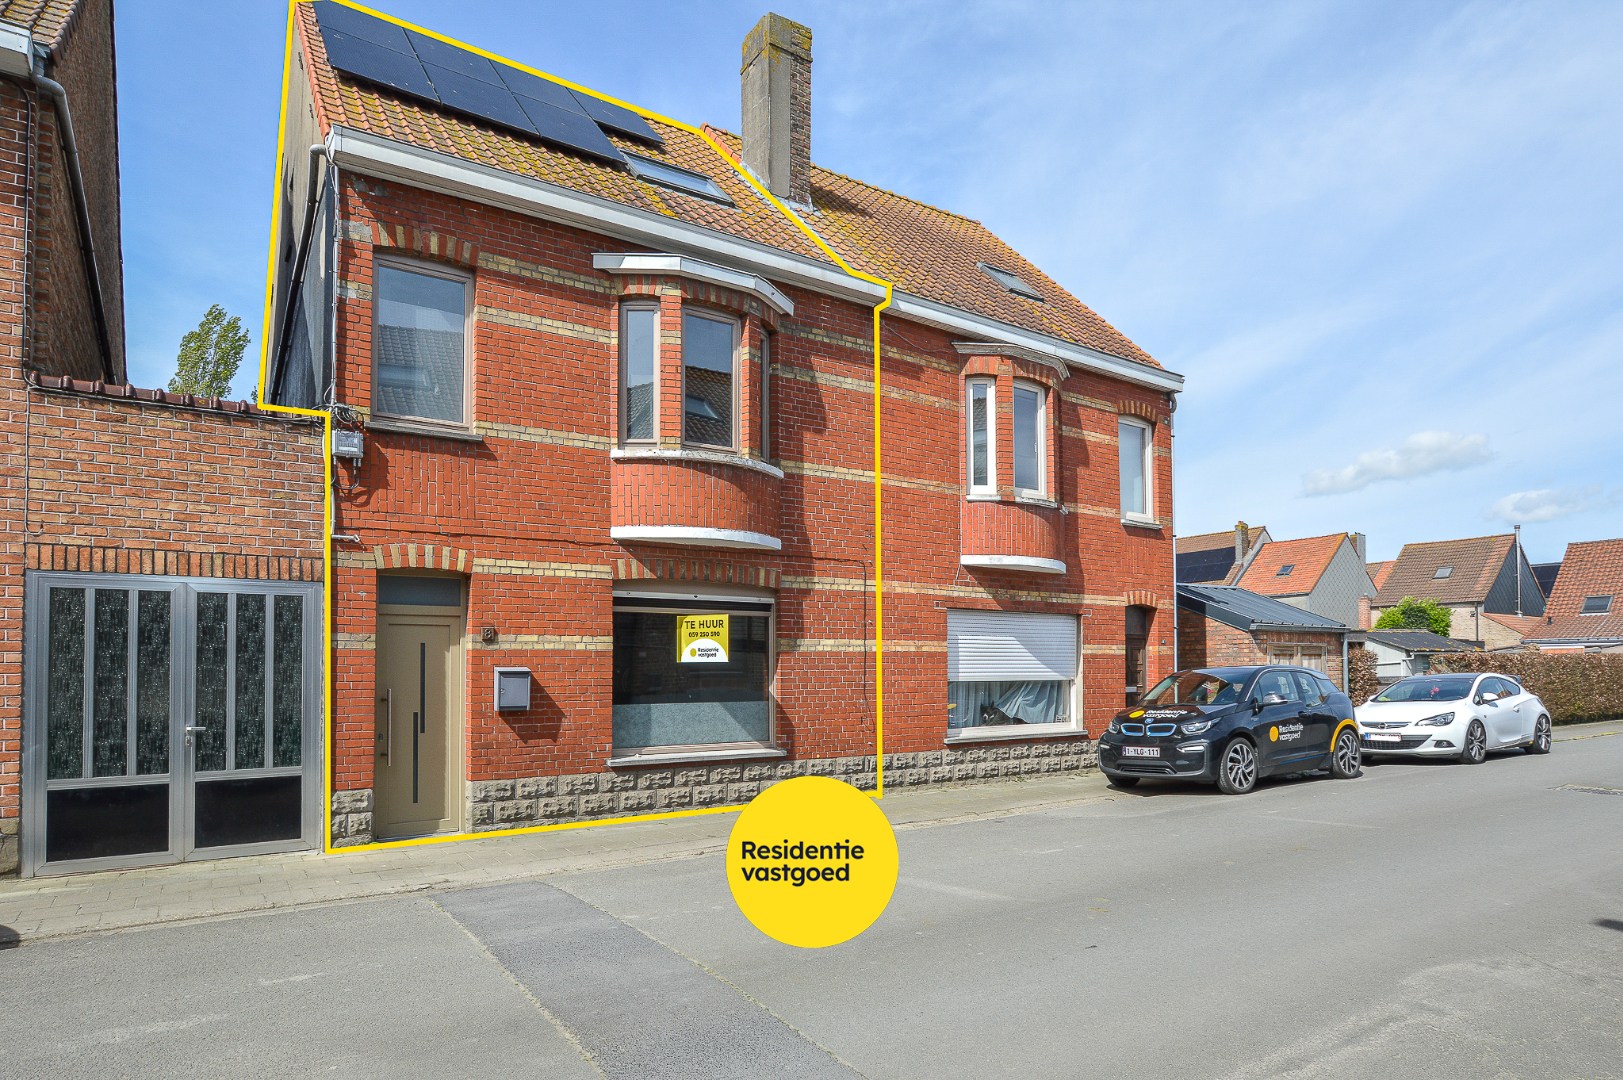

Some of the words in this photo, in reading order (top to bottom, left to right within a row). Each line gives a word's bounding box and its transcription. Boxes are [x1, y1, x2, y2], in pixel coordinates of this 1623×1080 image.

[684, 620, 696, 629] TE
[698, 620, 724, 628] HUUR
[1278, 722, 1304, 733] Residentie
[1279, 731, 1301, 742] vastgoed
